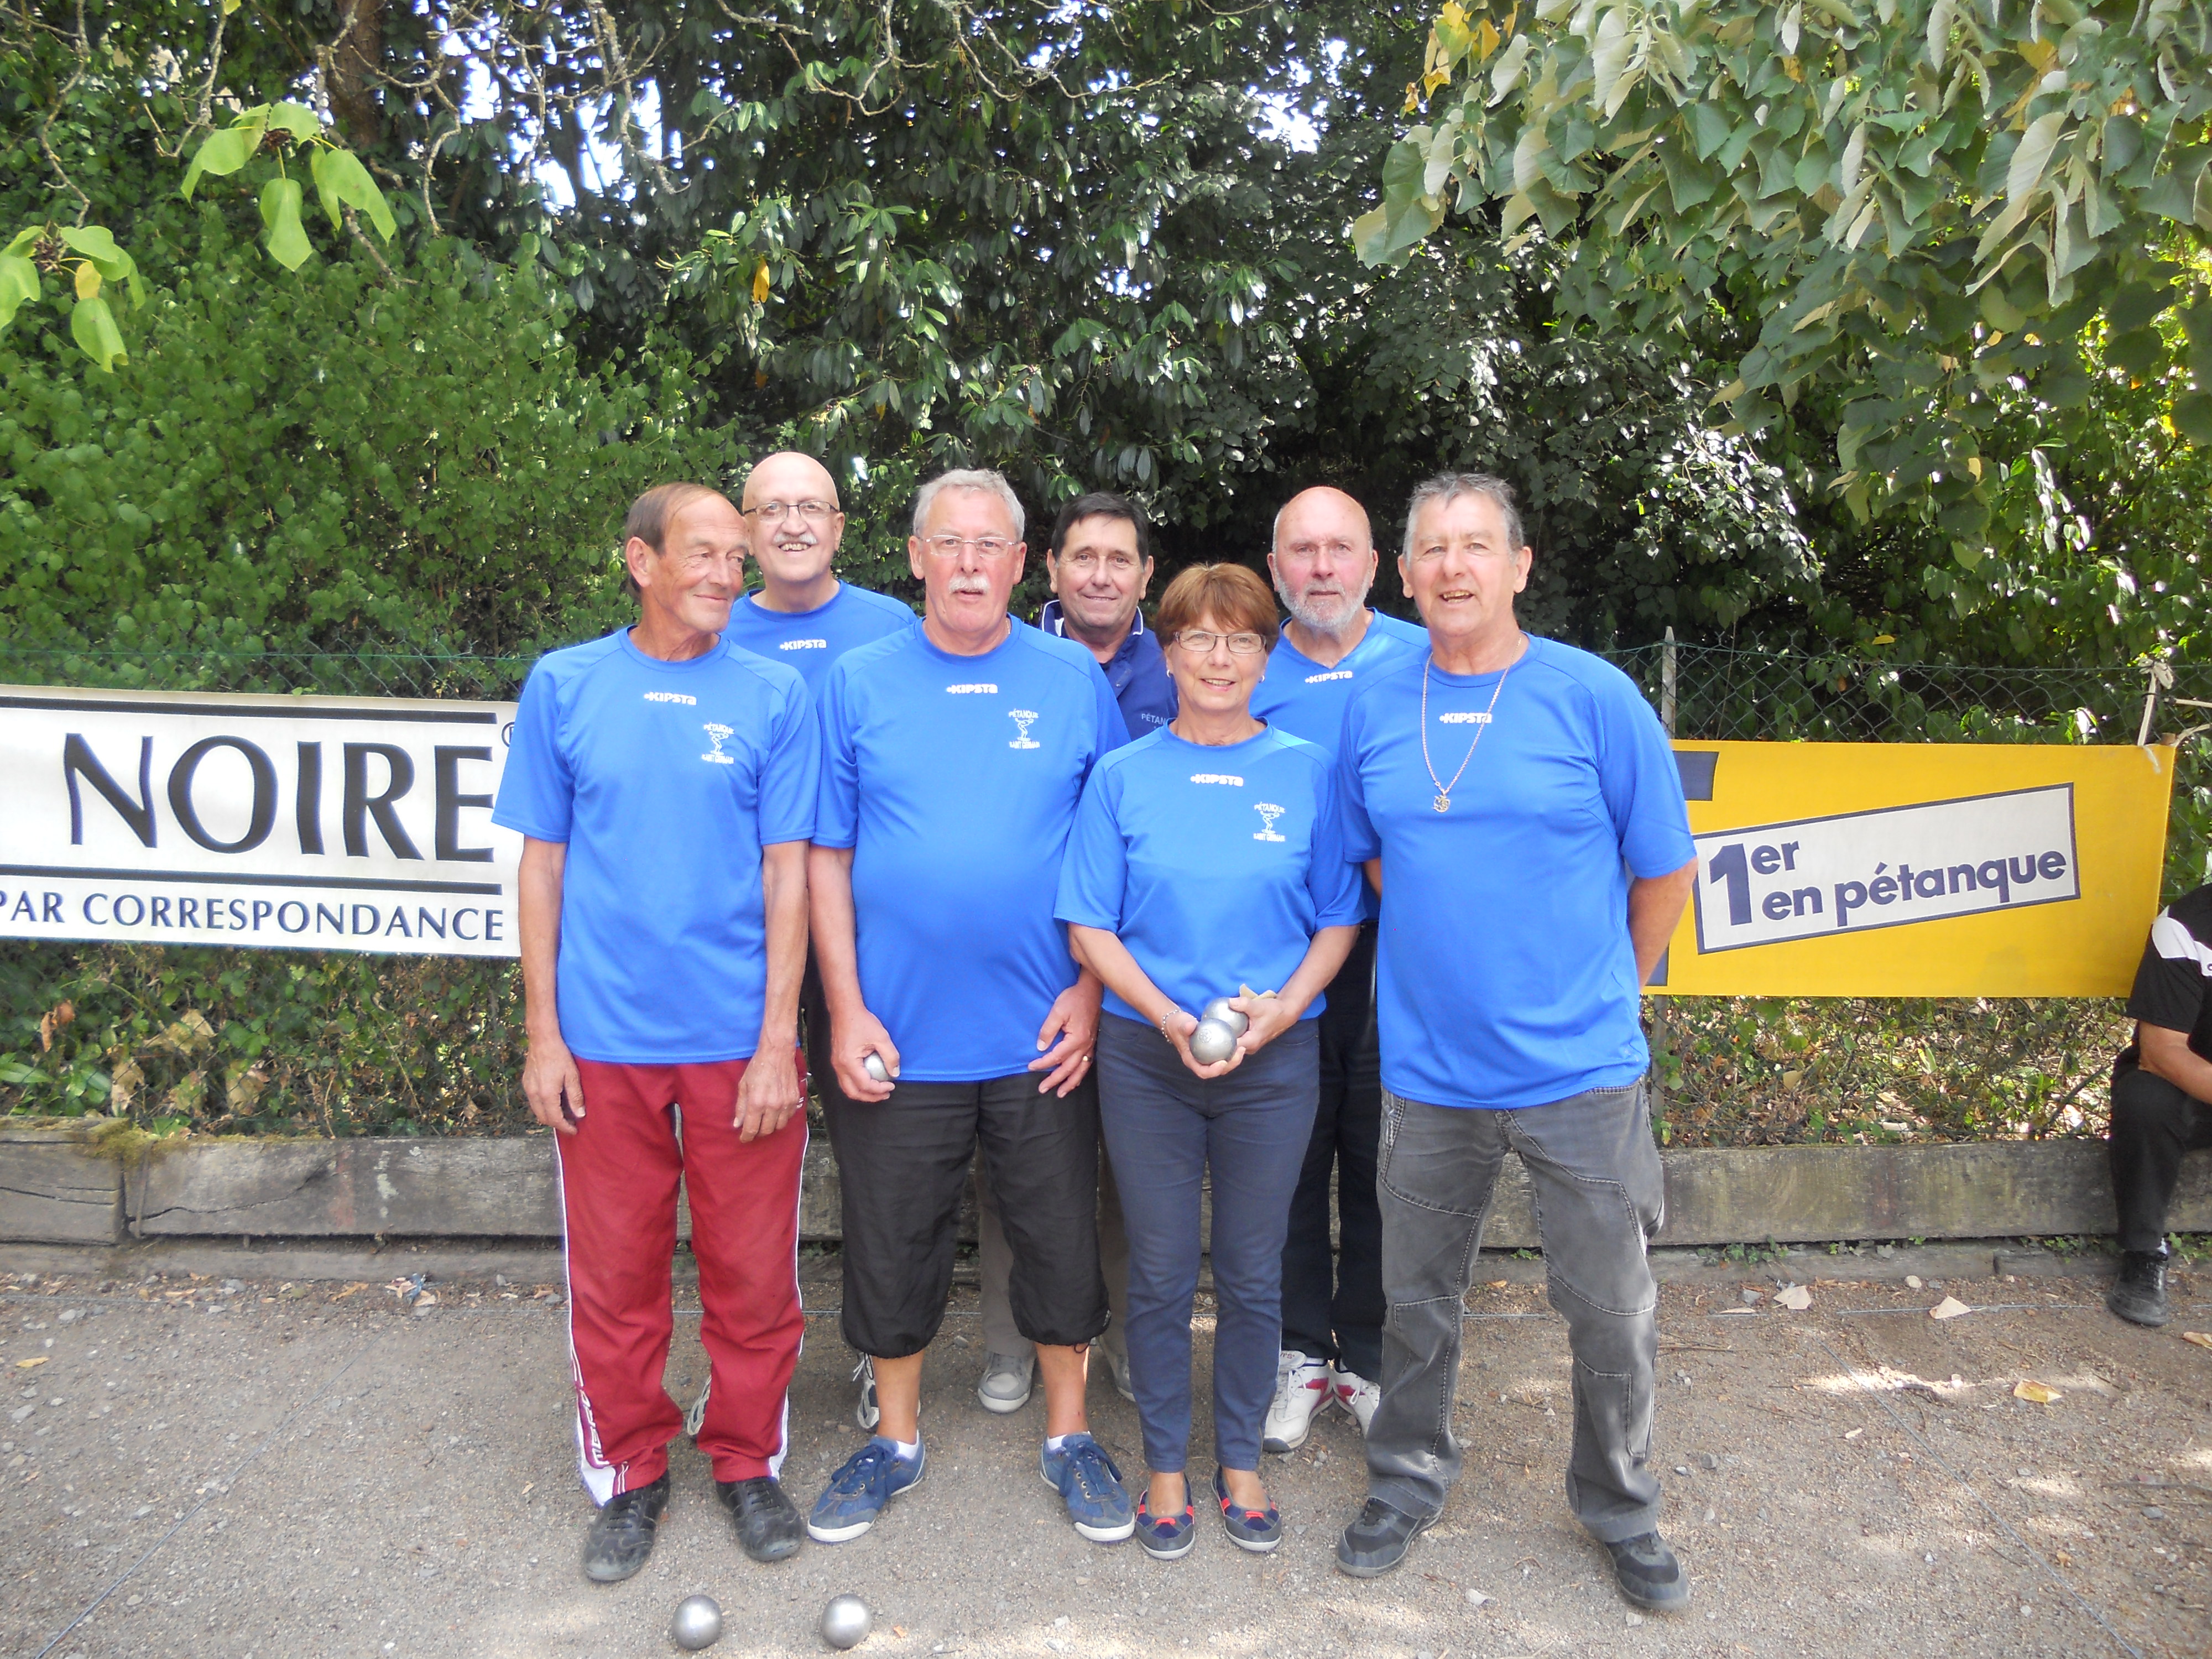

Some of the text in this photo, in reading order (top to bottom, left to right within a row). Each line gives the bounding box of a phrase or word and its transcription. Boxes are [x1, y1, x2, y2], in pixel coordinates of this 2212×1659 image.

[64, 732, 494, 863] NOIRE
[82, 893, 504, 941] CORRESPONDANCE
[1708, 839, 1799, 926] 1er
[1761, 847, 2067, 927] en pétanque
